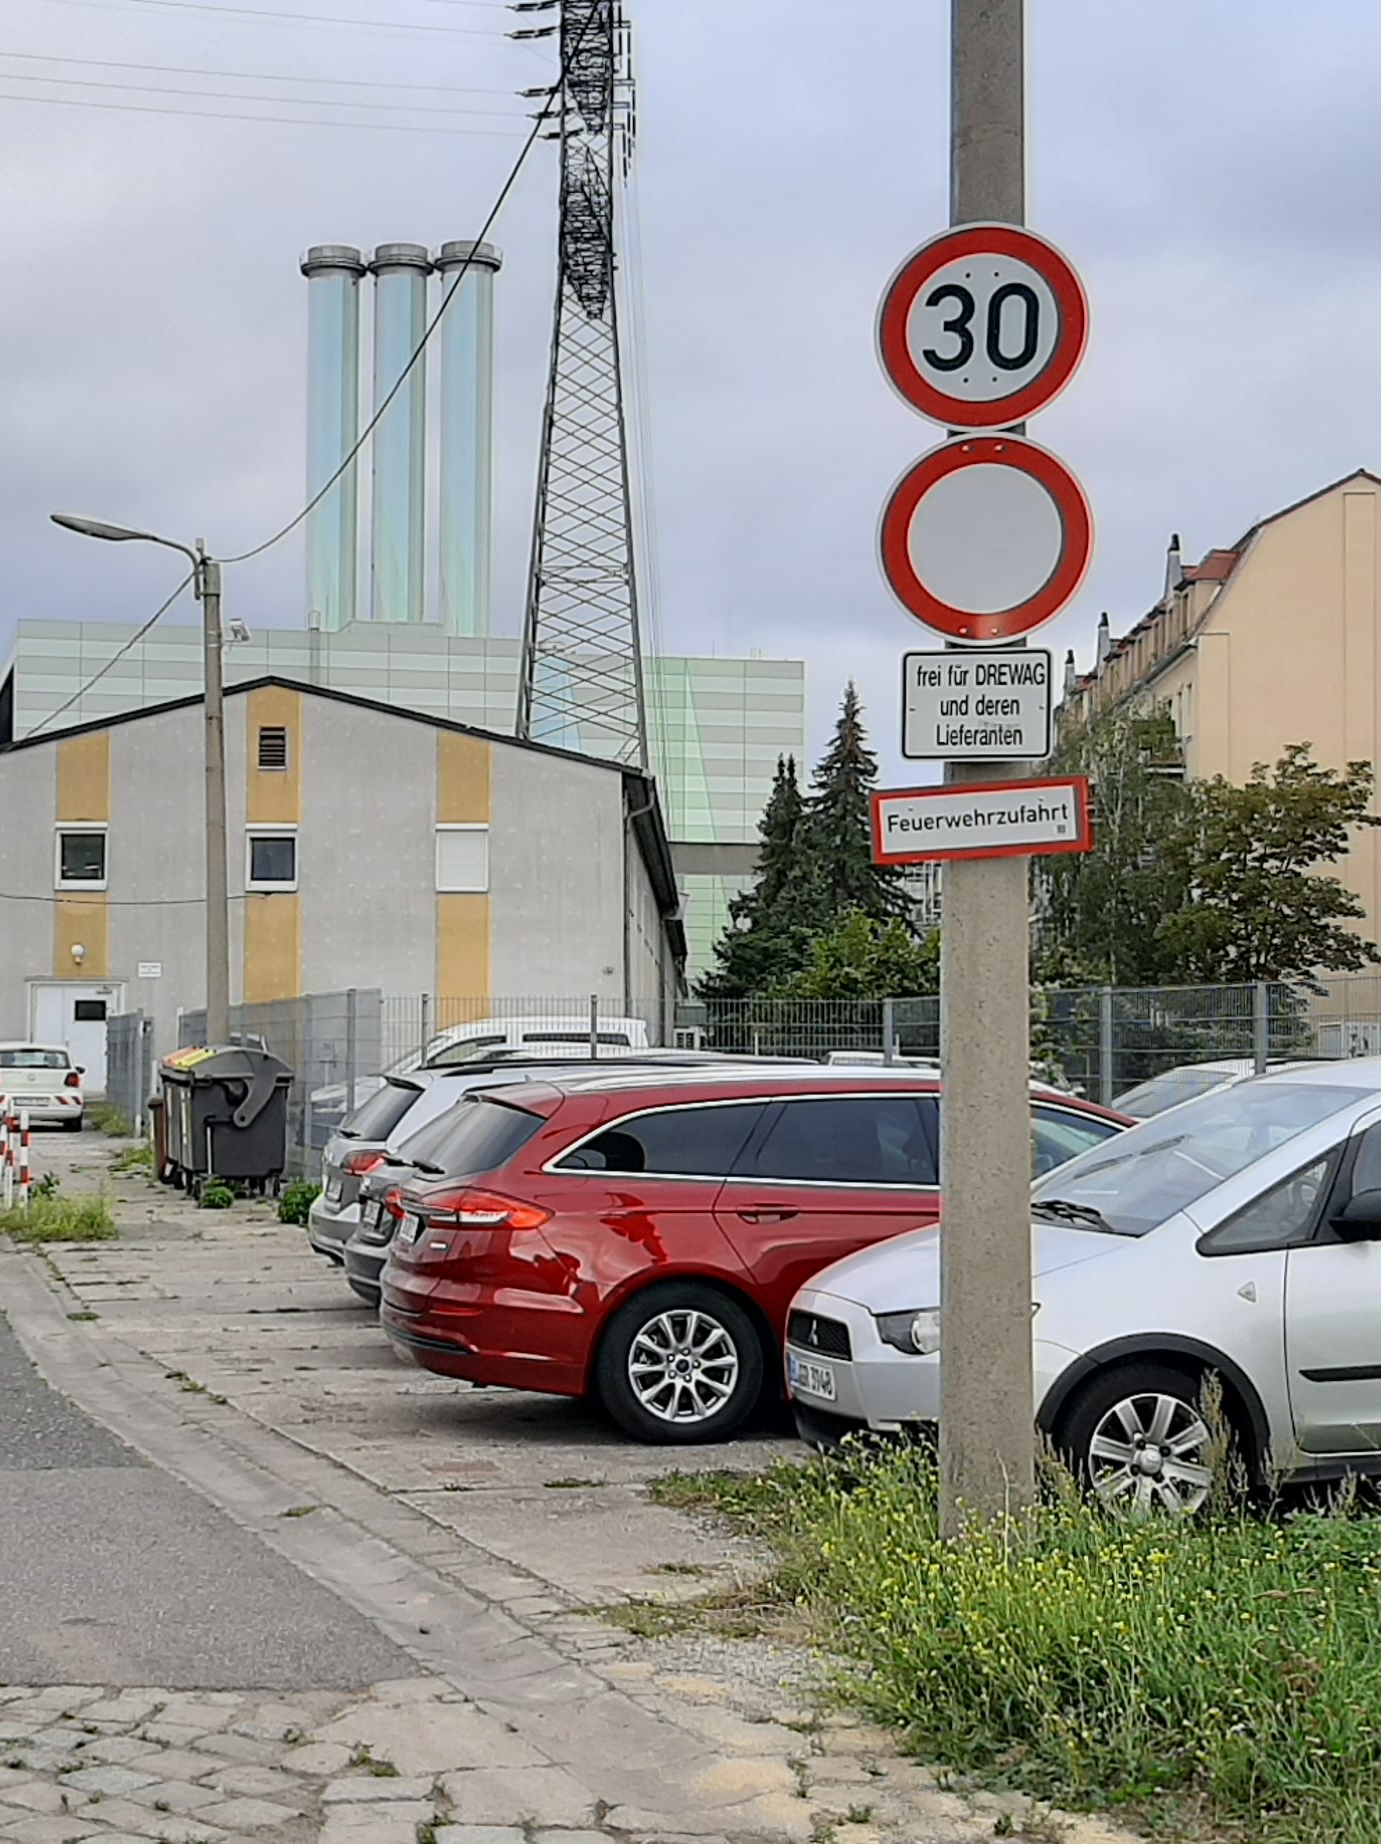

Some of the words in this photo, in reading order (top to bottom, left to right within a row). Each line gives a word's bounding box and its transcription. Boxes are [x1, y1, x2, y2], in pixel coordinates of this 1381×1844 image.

[922, 282, 1040, 372] 30
[916, 664, 942, 687] frei
[947, 663, 970, 687] für
[975, 662, 1046, 686] DREWAG
[940, 694, 969, 716] und
[975, 693, 1020, 716] deren
[936, 723, 1023, 746] Lieferanten
[887, 803, 1068, 833] Feuerwehrzufahrt
